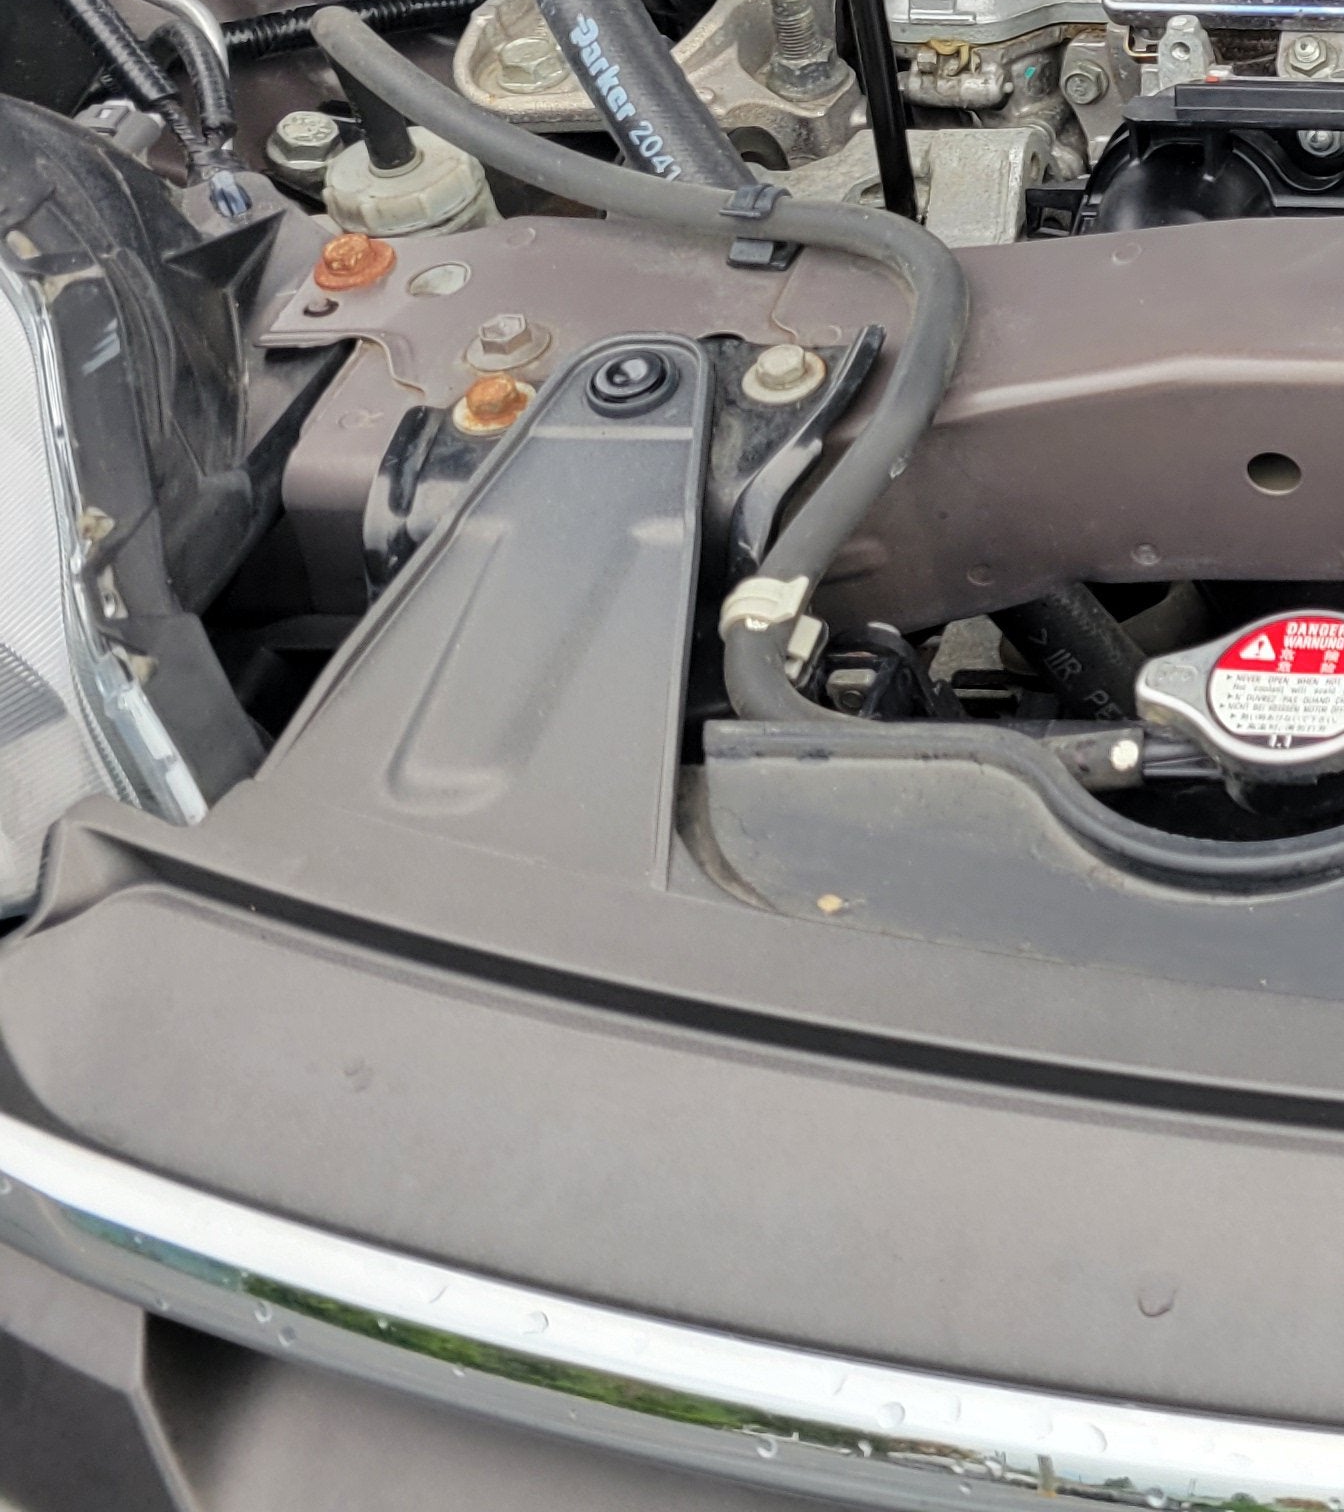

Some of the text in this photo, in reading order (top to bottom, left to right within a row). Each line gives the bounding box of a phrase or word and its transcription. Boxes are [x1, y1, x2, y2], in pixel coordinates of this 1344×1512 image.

[569, 13, 637, 123] Parker
[1236, 674, 1261, 684] NEVER
[1268, 675, 1290, 685] OPEN
[1296, 676, 1320, 686] WHEN
